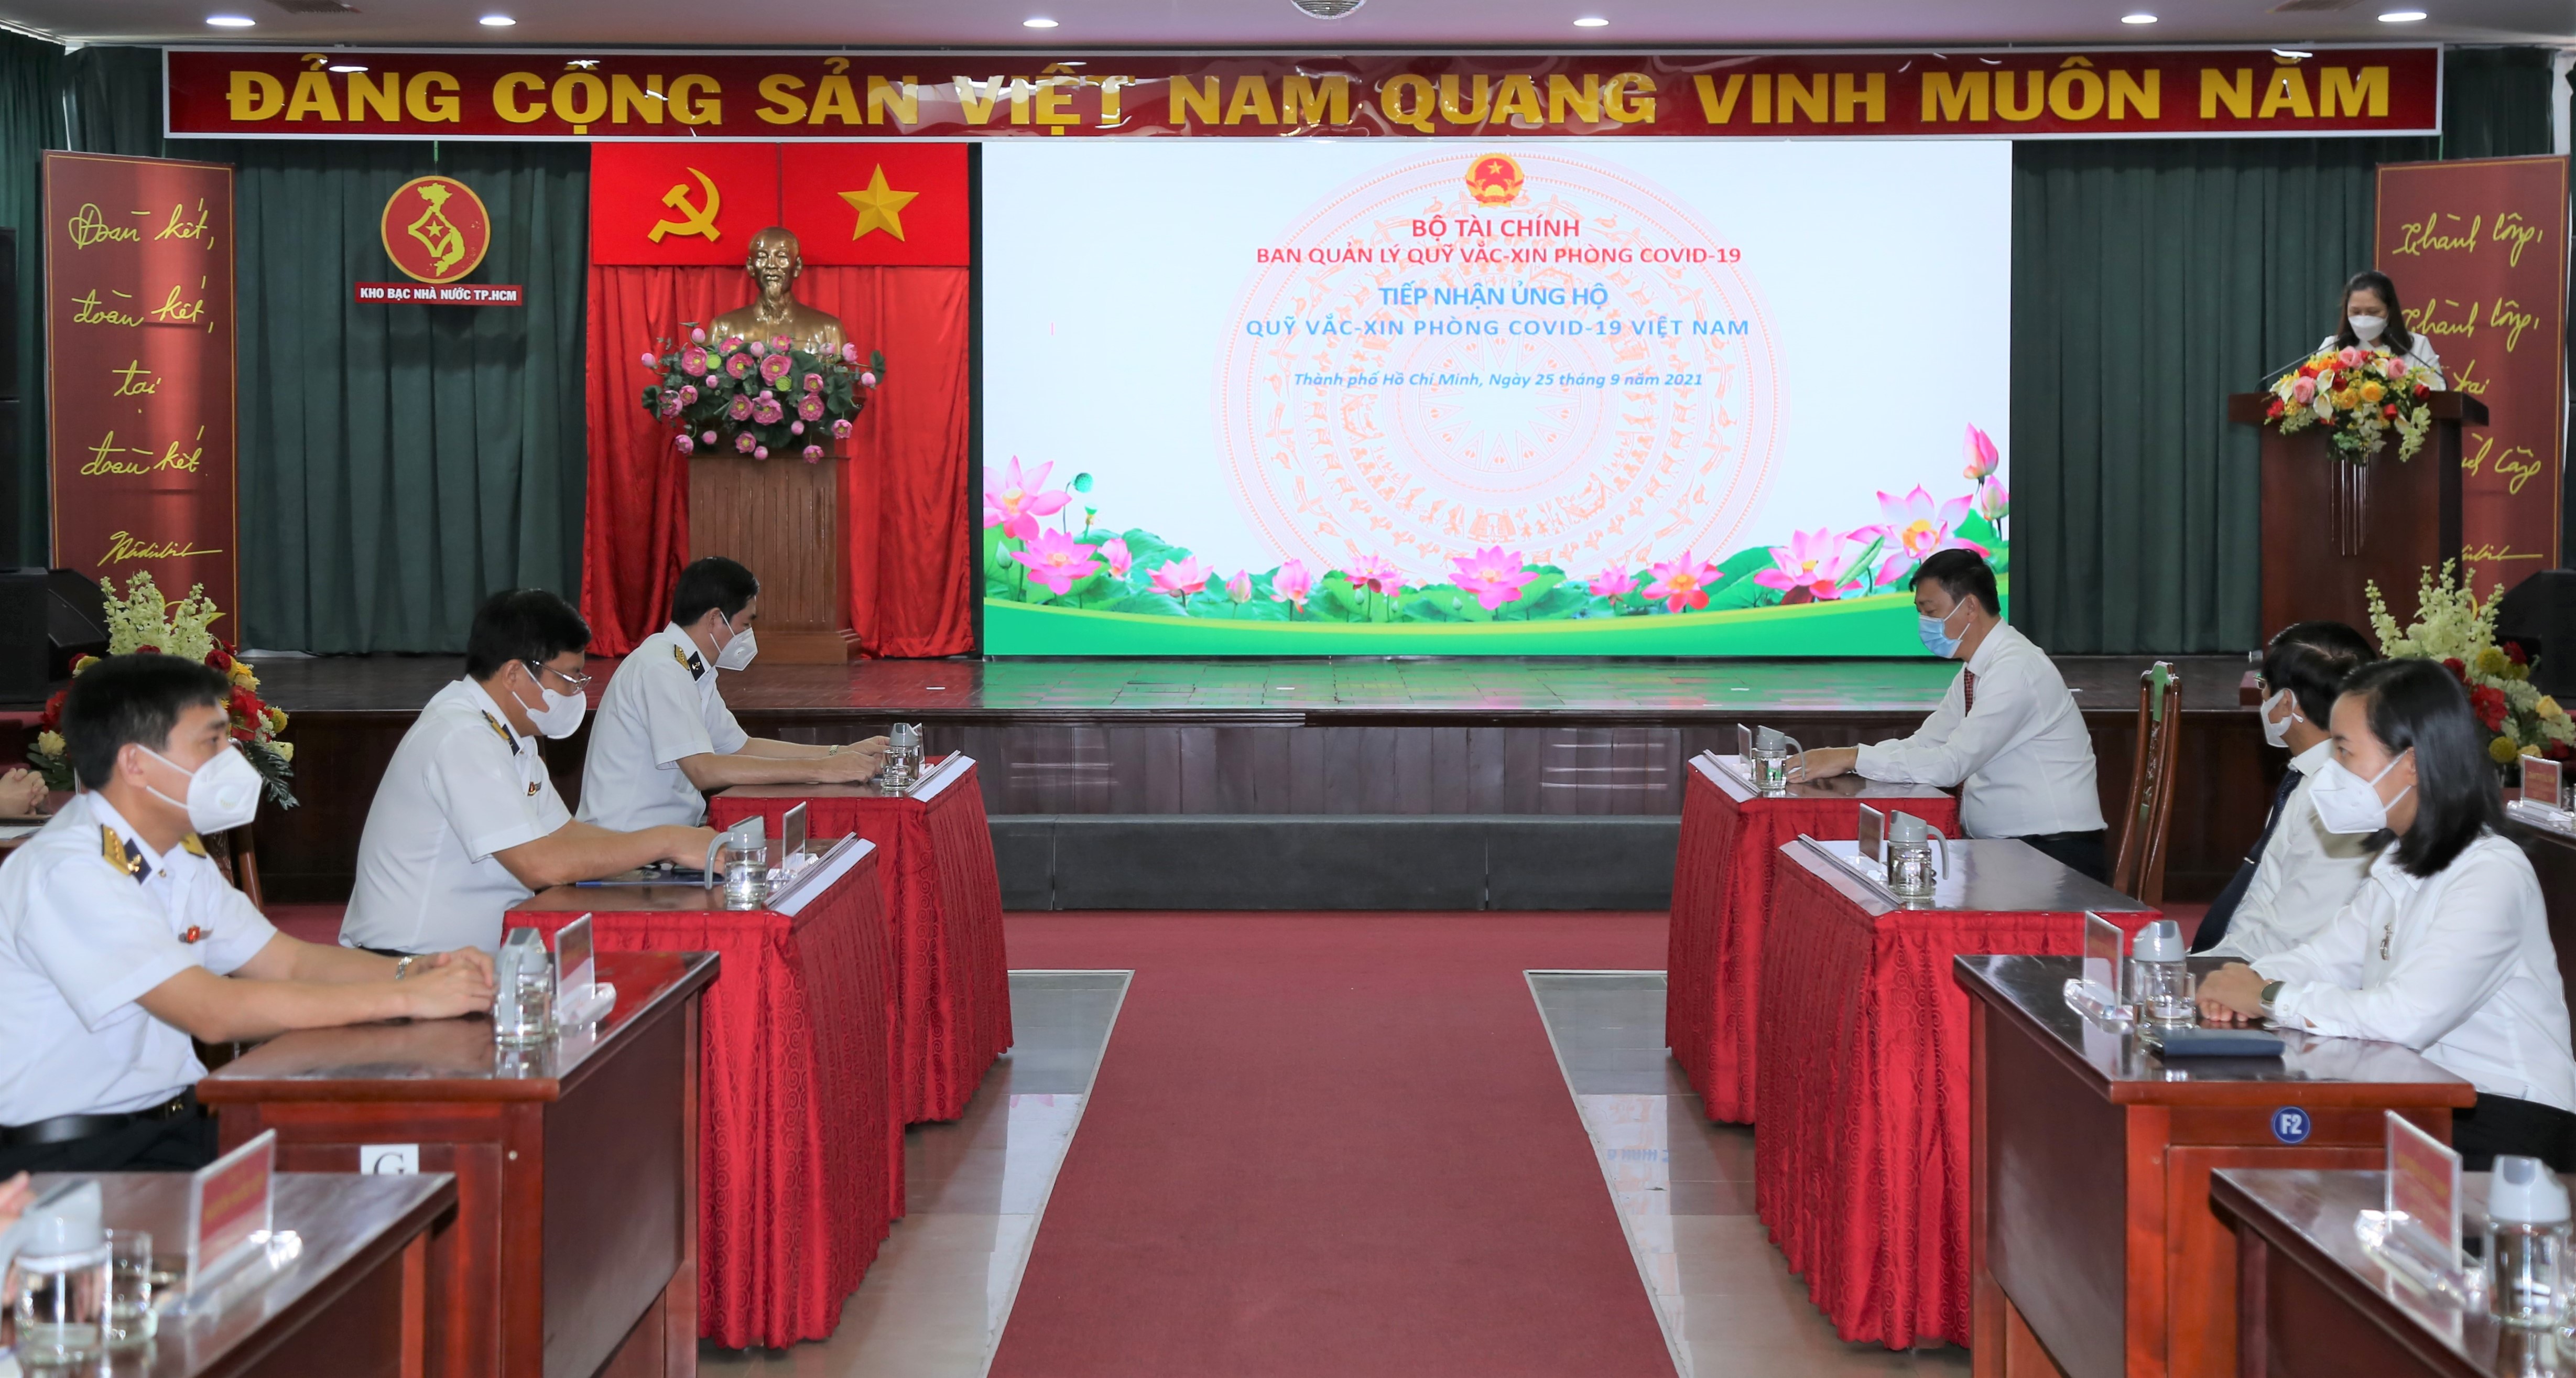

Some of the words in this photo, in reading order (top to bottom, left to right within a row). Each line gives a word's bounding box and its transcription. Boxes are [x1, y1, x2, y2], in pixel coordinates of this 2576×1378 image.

[226, 53, 460, 123] ĐẢNG
[493, 59, 722, 135] CỘNG
[755, 57, 918, 125] SẢN
[953, 62, 1136, 135] VIỆT
[1169, 74, 1350, 125] NAM
[1381, 72, 1656, 133] QUANG
[1693, 72, 1885, 124] VINH
[1921, 56, 2160, 122] MUÔN
[2201, 55, 2388, 119] NĂM
[1413, 214, 1447, 241] BỘ
[1455, 213, 1492, 236] TÀI
[1501, 215, 1580, 236] CHÍNH
[1257, 248, 1301, 263] BAN
[1310, 242, 1373, 265] QUẢN
[1381, 244, 1401, 263] LÝ
[1408, 245, 1454, 265] QUỸ
[1460, 240, 1546, 263] VẮC-XIN
[1555, 243, 1633, 263] PHÒNG
[1640, 248, 1741, 263] COVID-19
[360, 288, 384, 298] KHO
[387, 288, 410, 300] BẠC
[414, 287, 437, 299] NHÀ
[440, 287, 471, 300] NƯỚC
[474, 290, 517, 301] TP.HCM
[1378, 280, 1428, 305] TIẾP
[1434, 282, 1504, 309] NHẬN
[1512, 280, 1565, 305] ỦNG
[1573, 282, 1608, 309] HỘ
[1246, 316, 1296, 337] QUỸ
[1306, 313, 1403, 335] VẮC-XIN
[1415, 316, 1498, 335] PHÒNG
[1509, 320, 1622, 335] COVID-19
[1632, 316, 1683, 338] VIỆT
[1693, 320, 1748, 335] NAM
[1294, 372, 1343, 385] Thành
[1347, 370, 1380, 388] phố
[1383, 371, 1405, 385] Hồ
[1409, 372, 1433, 385] Chí
[1438, 372, 1483, 388] Minh,
[1489, 372, 1531, 388] Ngày
[1535, 373, 1554, 385] 25
[1559, 372, 1606, 388] tháng
[1611, 373, 1620, 385] 9
[1624, 373, 1659, 385] năm
[1665, 373, 1702, 385] 2021
[2280, 1114, 2302, 1135] F2
